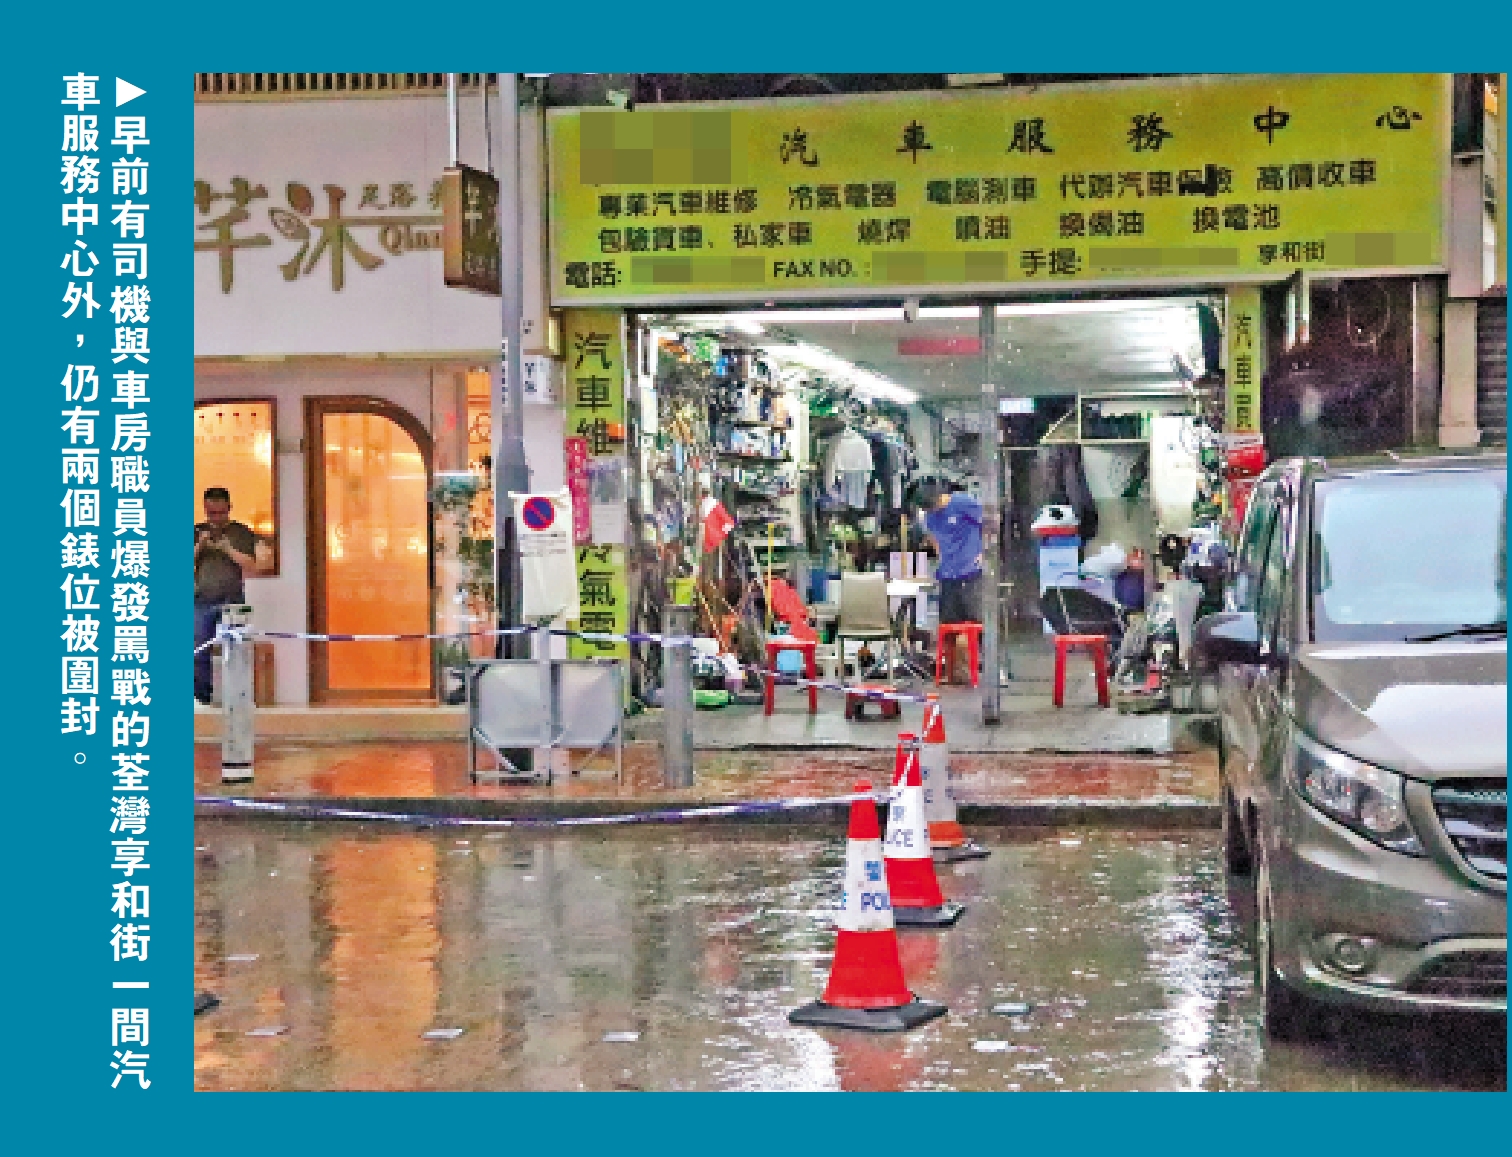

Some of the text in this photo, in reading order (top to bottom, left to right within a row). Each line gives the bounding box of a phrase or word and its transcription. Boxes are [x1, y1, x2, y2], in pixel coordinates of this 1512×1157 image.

[780, 104, 1422, 168] 汽車服務中心
[599, 188, 757, 219] 專業汽車維修
[773, 260, 814, 278] FAX
